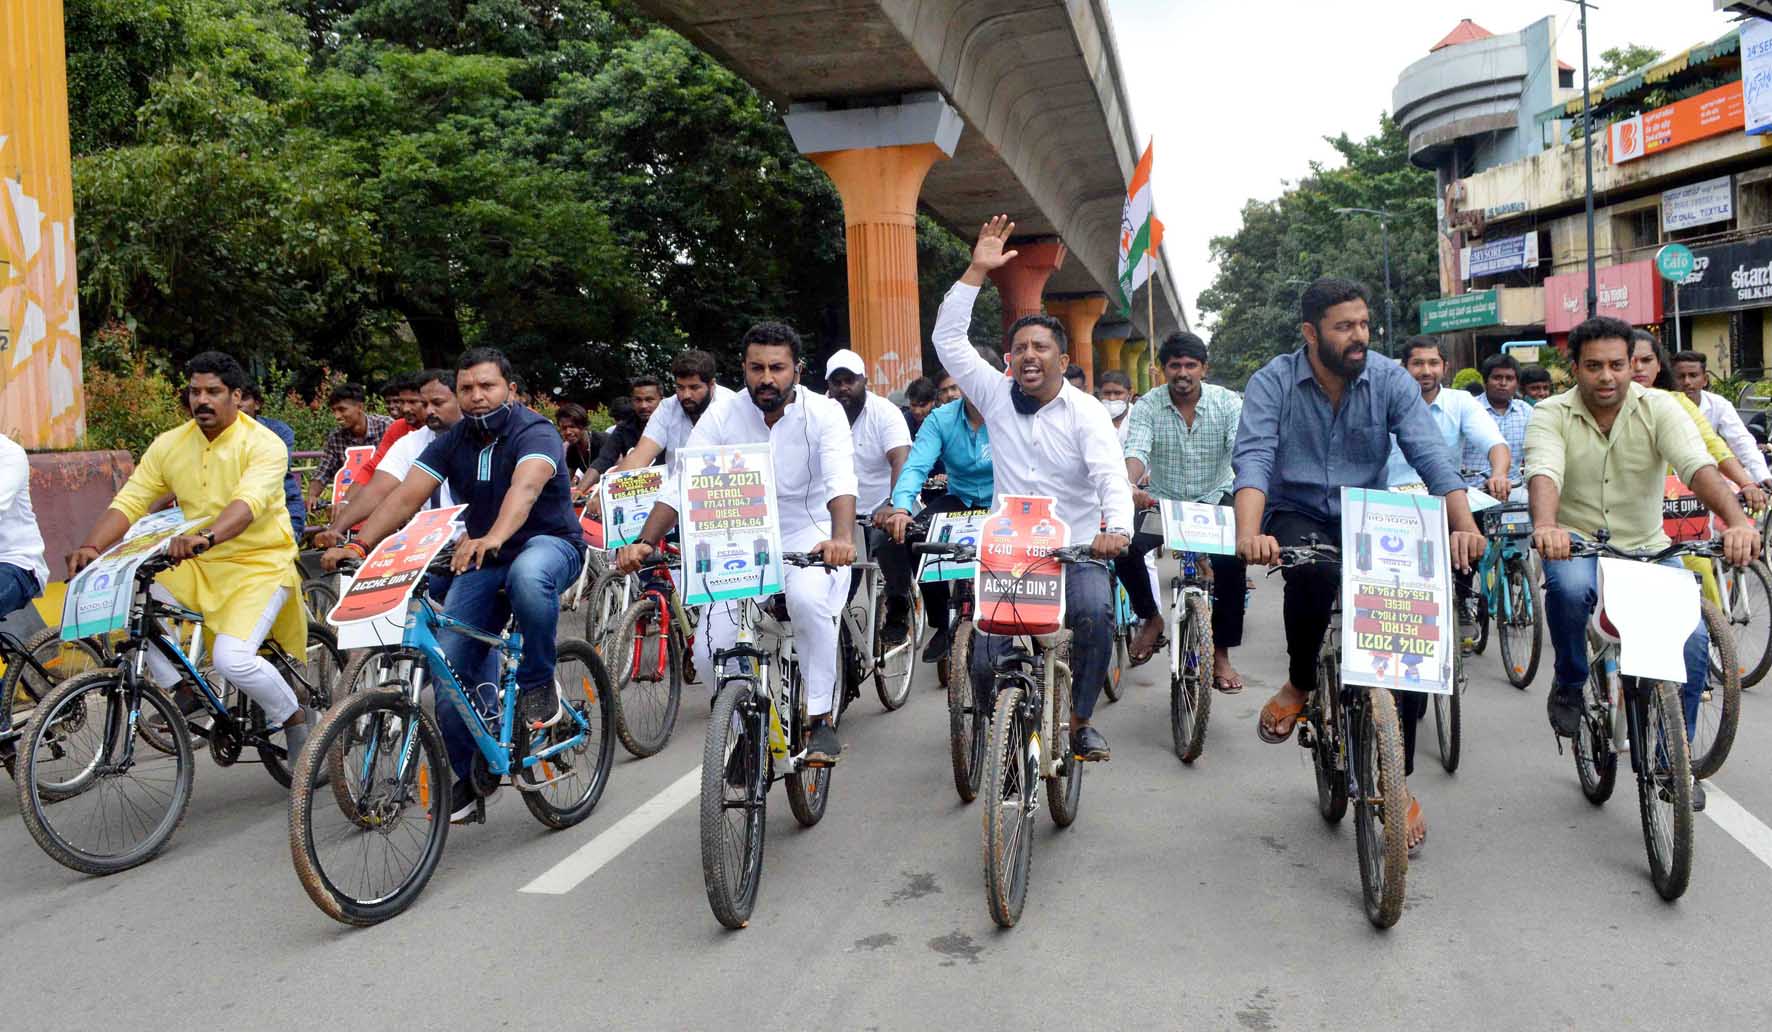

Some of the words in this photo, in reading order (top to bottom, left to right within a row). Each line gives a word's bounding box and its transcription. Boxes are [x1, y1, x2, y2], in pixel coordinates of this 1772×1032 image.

[692, 475, 724, 489] 2014
[728, 472, 760, 487] 2021
[707, 488, 743, 499] PETROL
[1680, 499, 1698, 512] DIN
[715, 508, 740, 518] DIESEL
[698, 520, 729, 530] ₹55.49
[731, 517, 762, 528] ₹94.04
[988, 543, 1013, 555] ₹410
[351, 578, 387, 592] ACCHE
[388, 574, 408, 585] DIN
[1026, 580, 1047, 596] DIN
[1049, 581, 1057, 597] ?
[1383, 598, 1411, 610] DIESEL
[1379, 621, 1418, 635] PETROL
[1359, 633, 1392, 650] 2021
[1399, 638, 1434, 655] 2014
